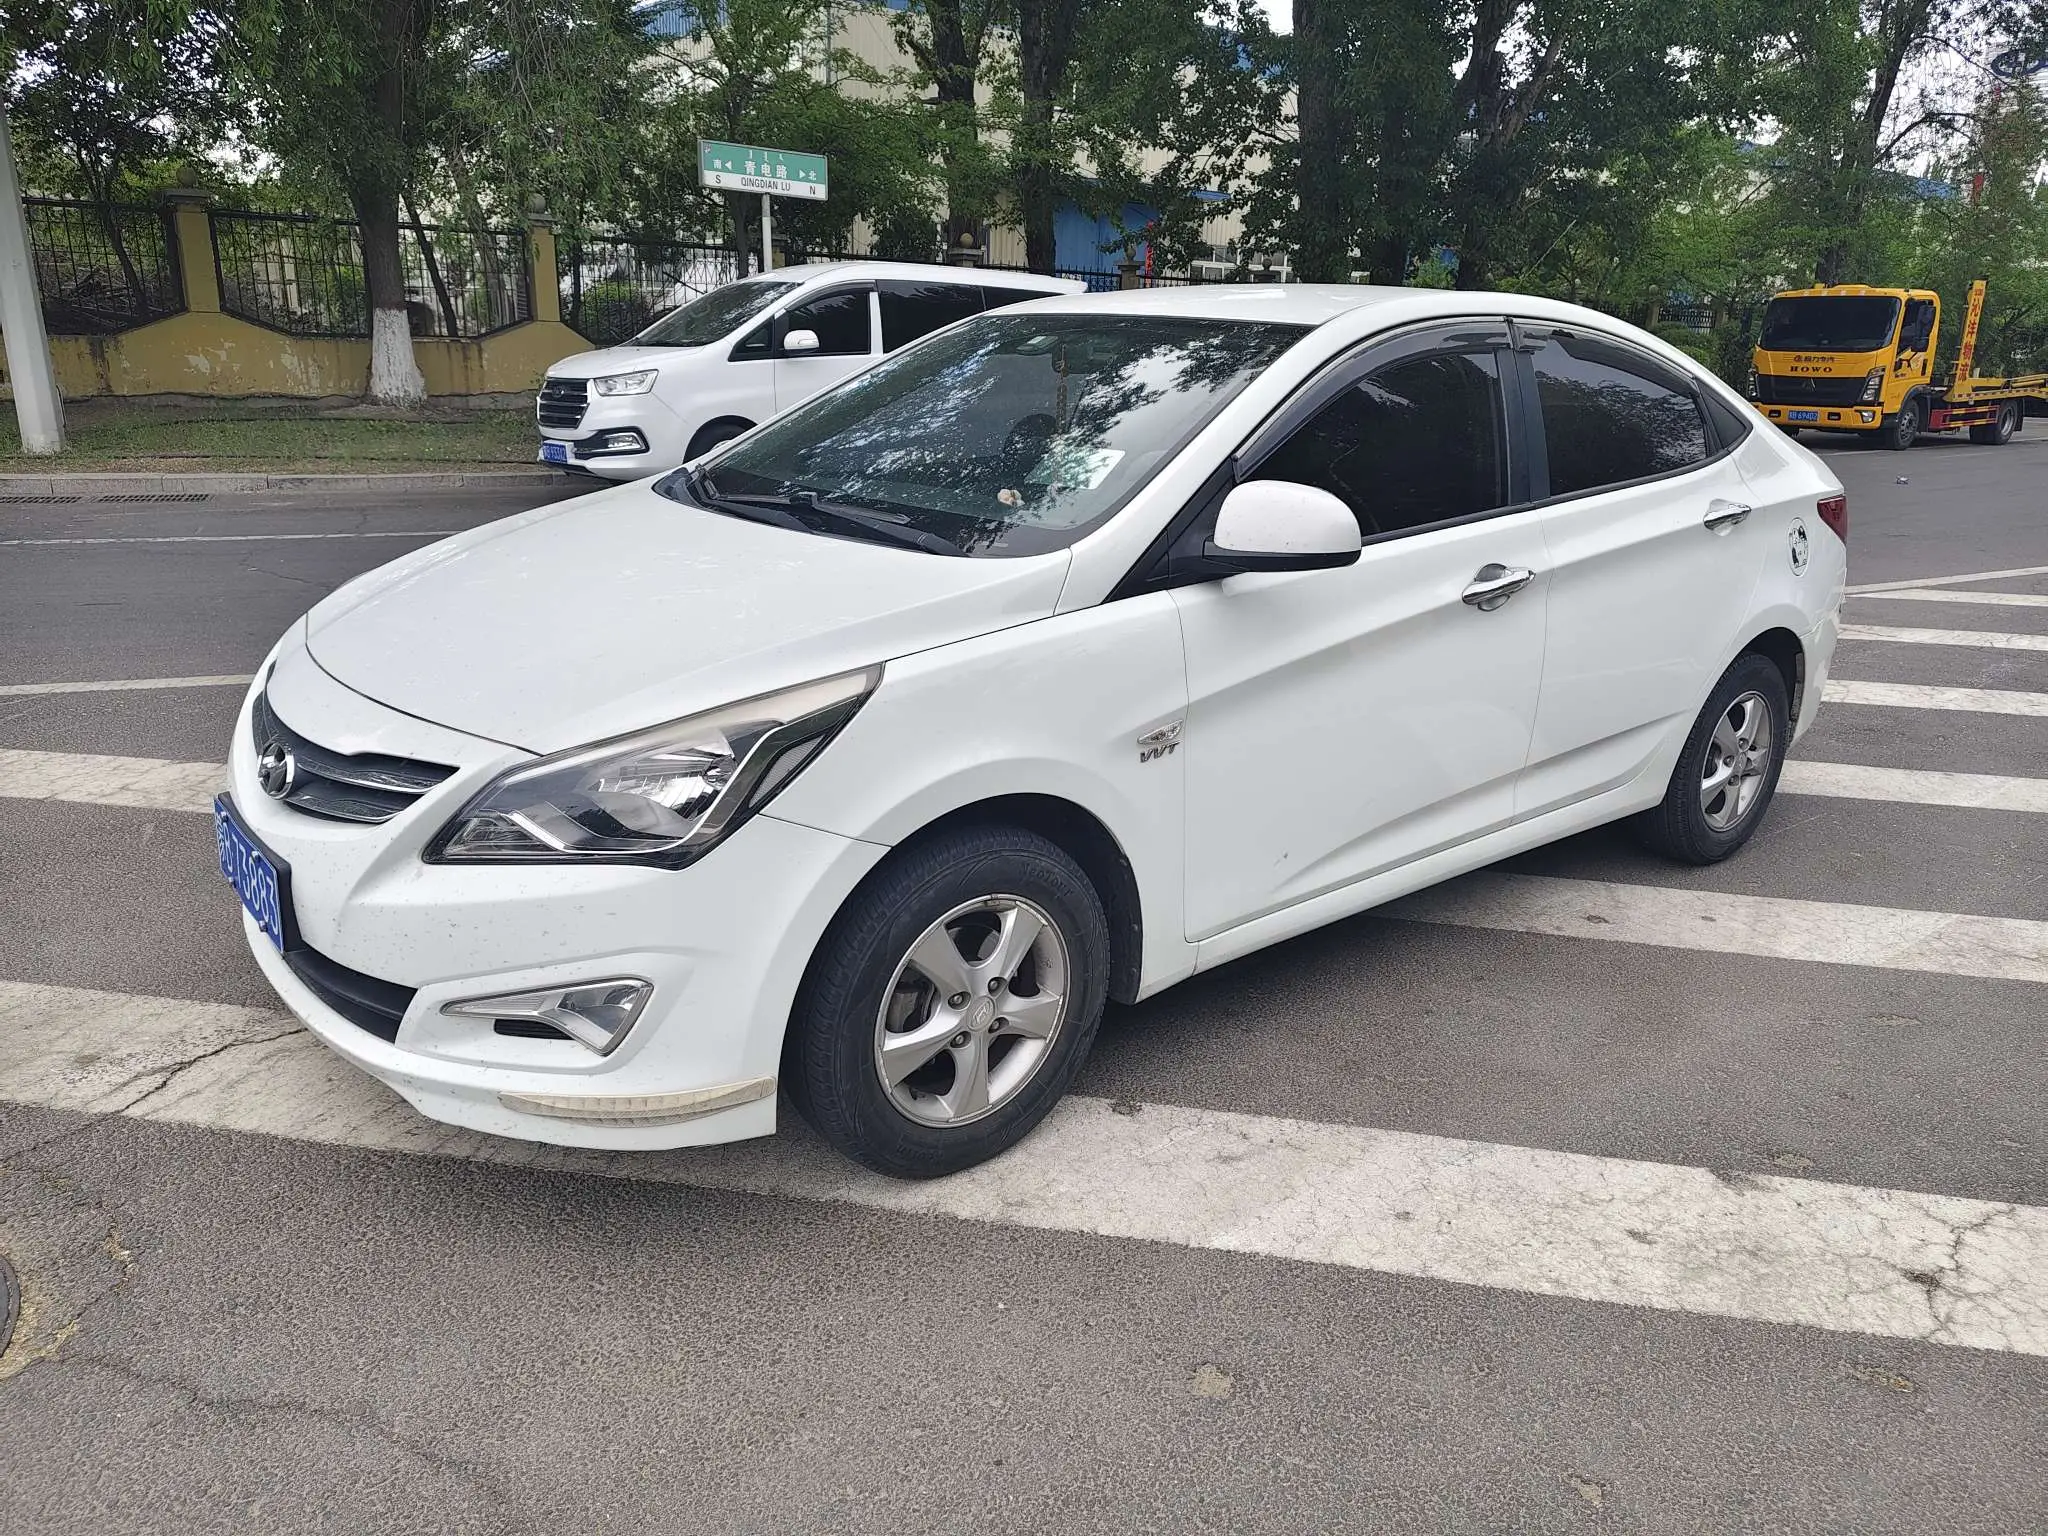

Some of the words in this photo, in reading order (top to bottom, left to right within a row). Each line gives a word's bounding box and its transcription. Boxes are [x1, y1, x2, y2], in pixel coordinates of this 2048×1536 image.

[713, 159, 722, 170] 南
[744, 160, 788, 179] 青电路
[808, 170, 817, 181] 北
[715, 174, 721, 184] S
[741, 177, 778, 190] QINGDIAN
[781, 181, 791, 192] LU
[809, 186, 816, 196] N
[1790, 365, 1832, 373] HOWO
